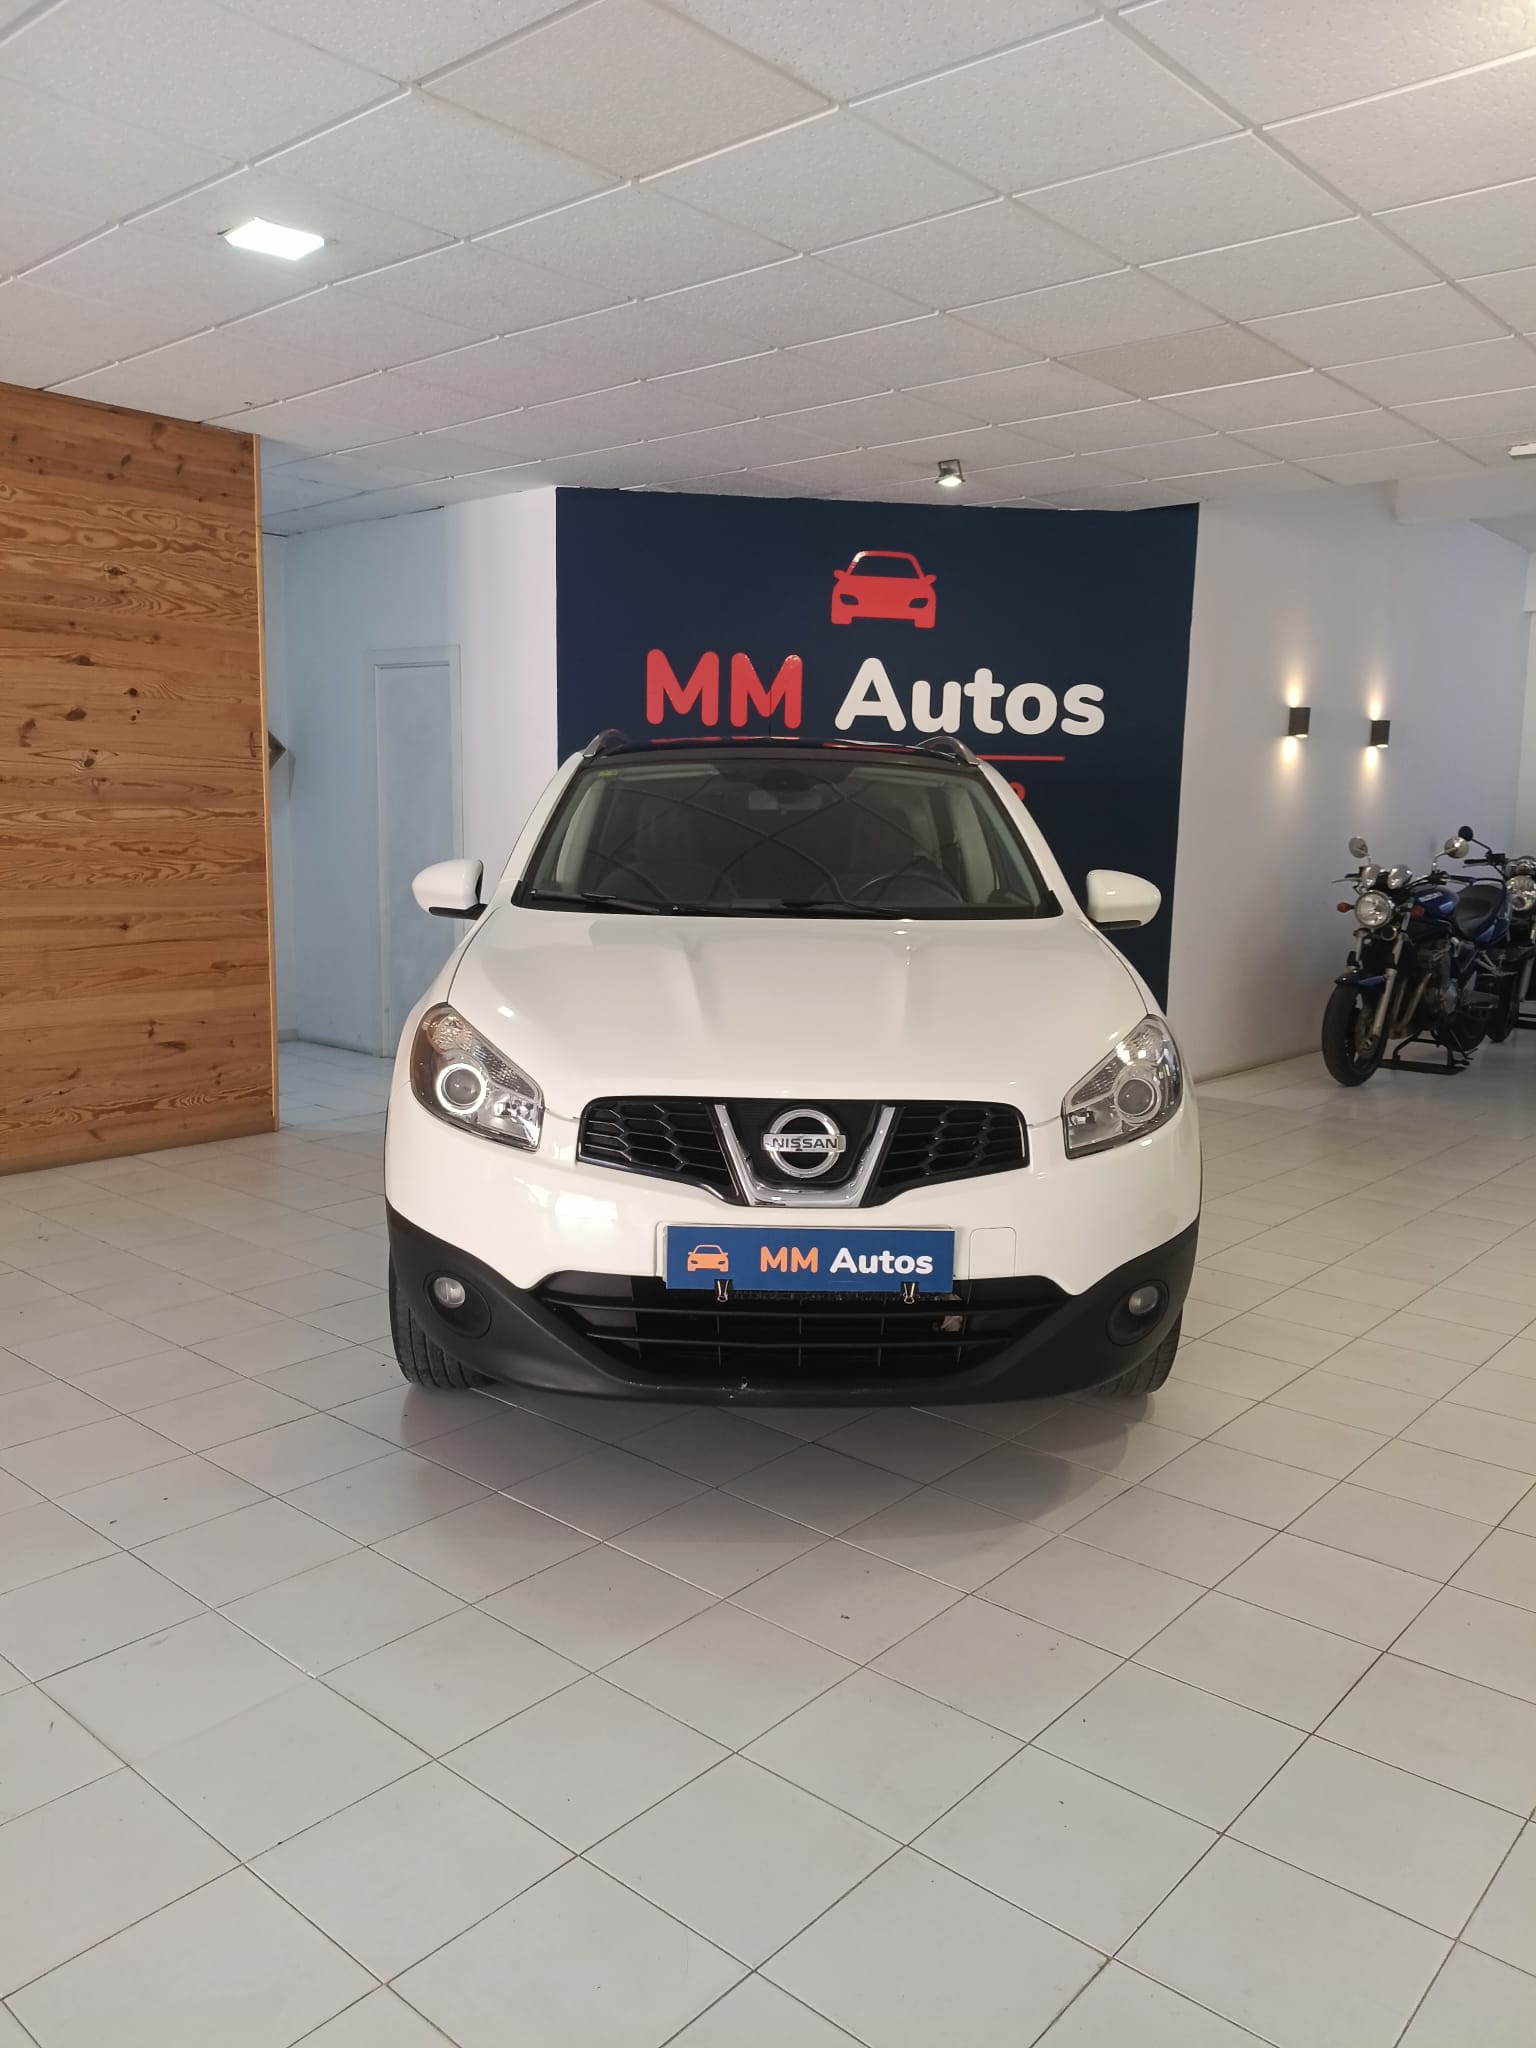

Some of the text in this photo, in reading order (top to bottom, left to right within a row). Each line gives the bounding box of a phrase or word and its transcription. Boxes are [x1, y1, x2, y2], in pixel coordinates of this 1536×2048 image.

[645, 649, 1105, 736] MM Autos
[772, 1137, 838, 1149] NISSAN
[759, 1246, 933, 1275] MM Autos
